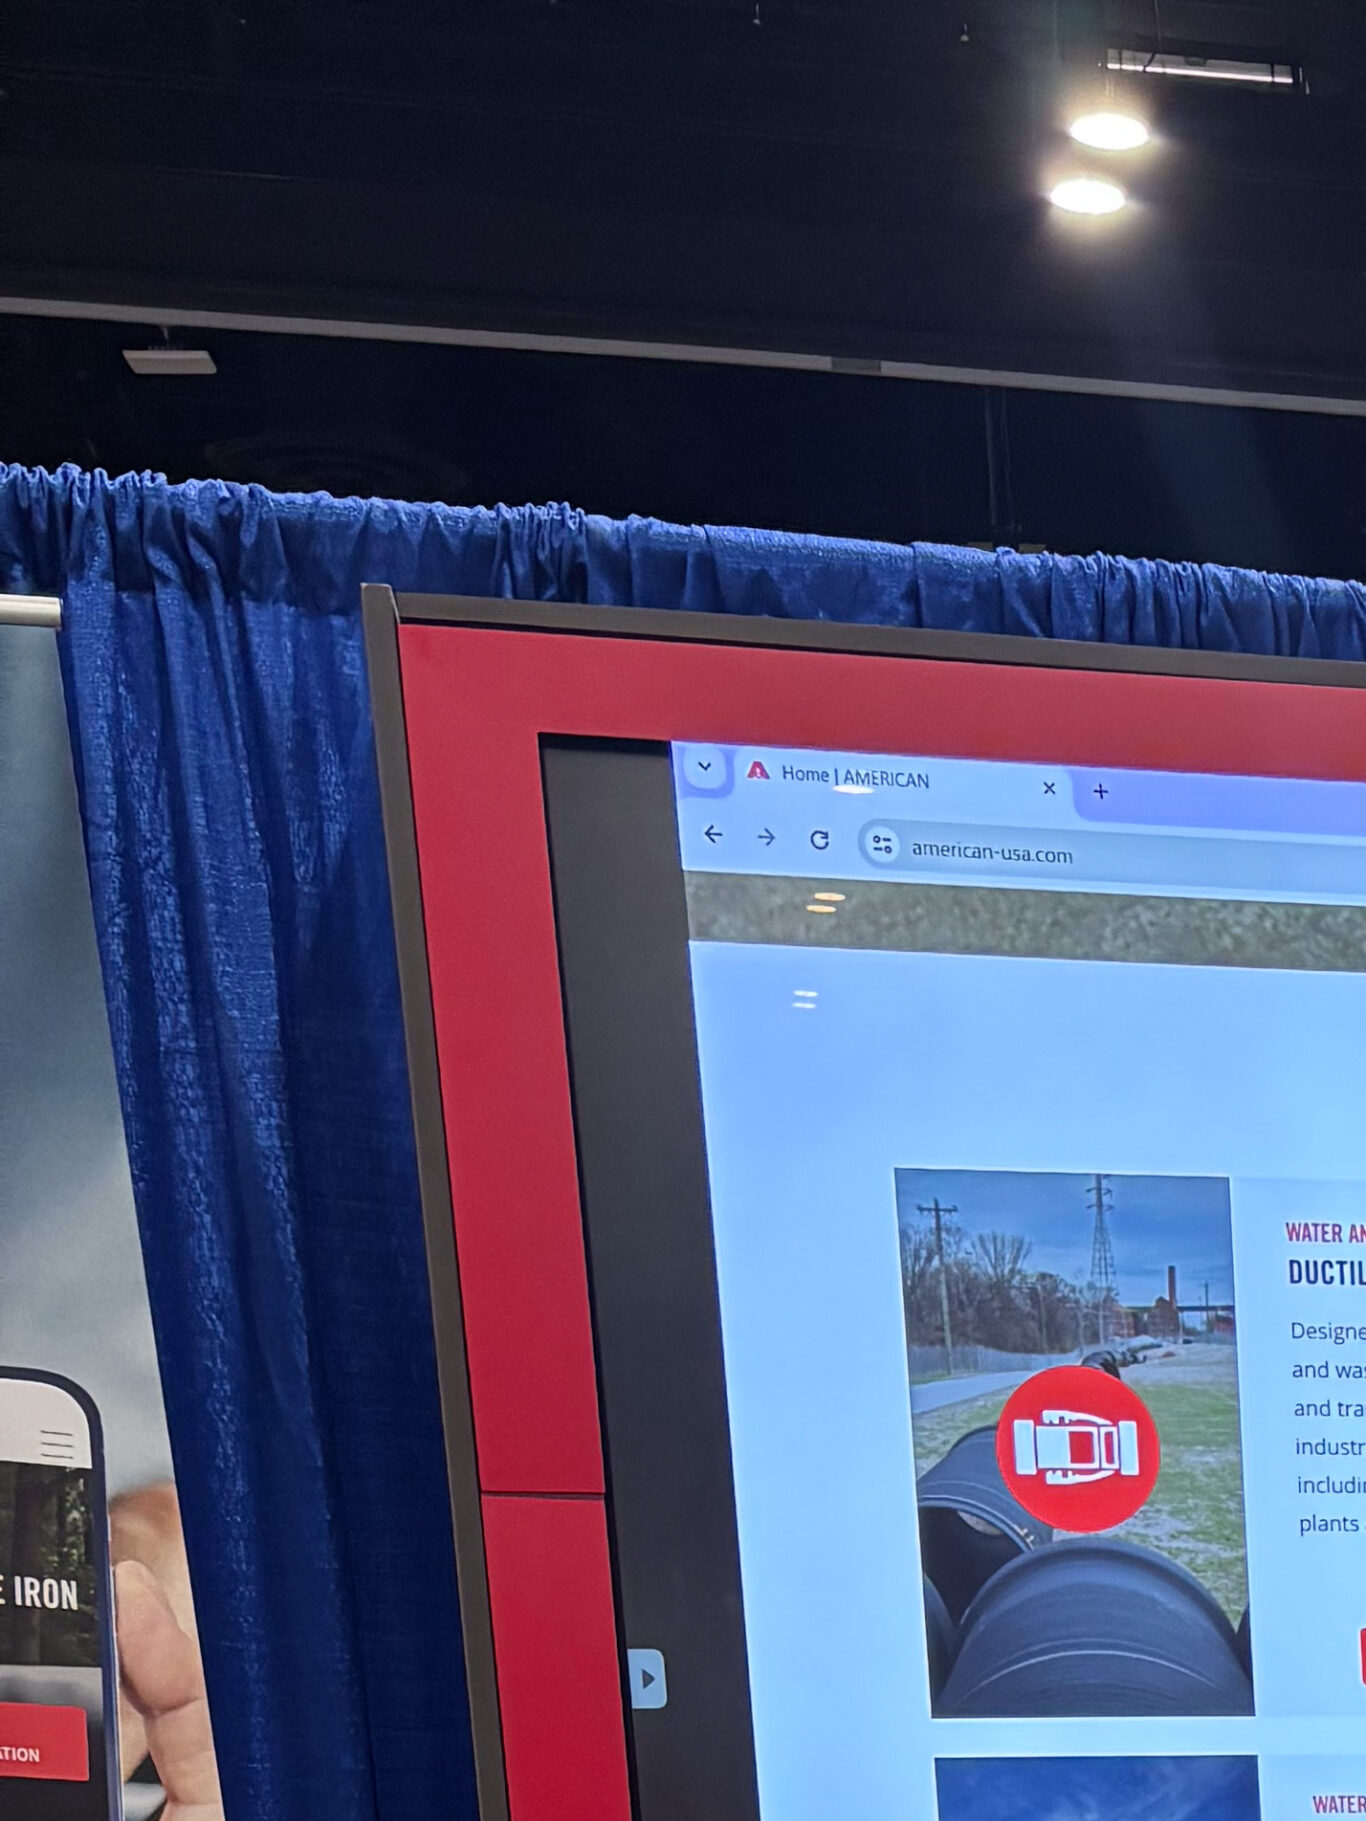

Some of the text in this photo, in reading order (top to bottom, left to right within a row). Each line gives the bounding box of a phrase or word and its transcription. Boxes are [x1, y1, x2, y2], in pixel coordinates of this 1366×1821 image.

[783, 765, 930, 790] Home AMERICAN
[913, 842, 1072, 864] american-usa.com
[1286, 1221, 1342, 1243] WATER
[1293, 1361, 1329, 1379] and
[1295, 1399, 1330, 1417] and
[1300, 1514, 1359, 1537] plants
[14, 1576, 78, 1611] IRON
